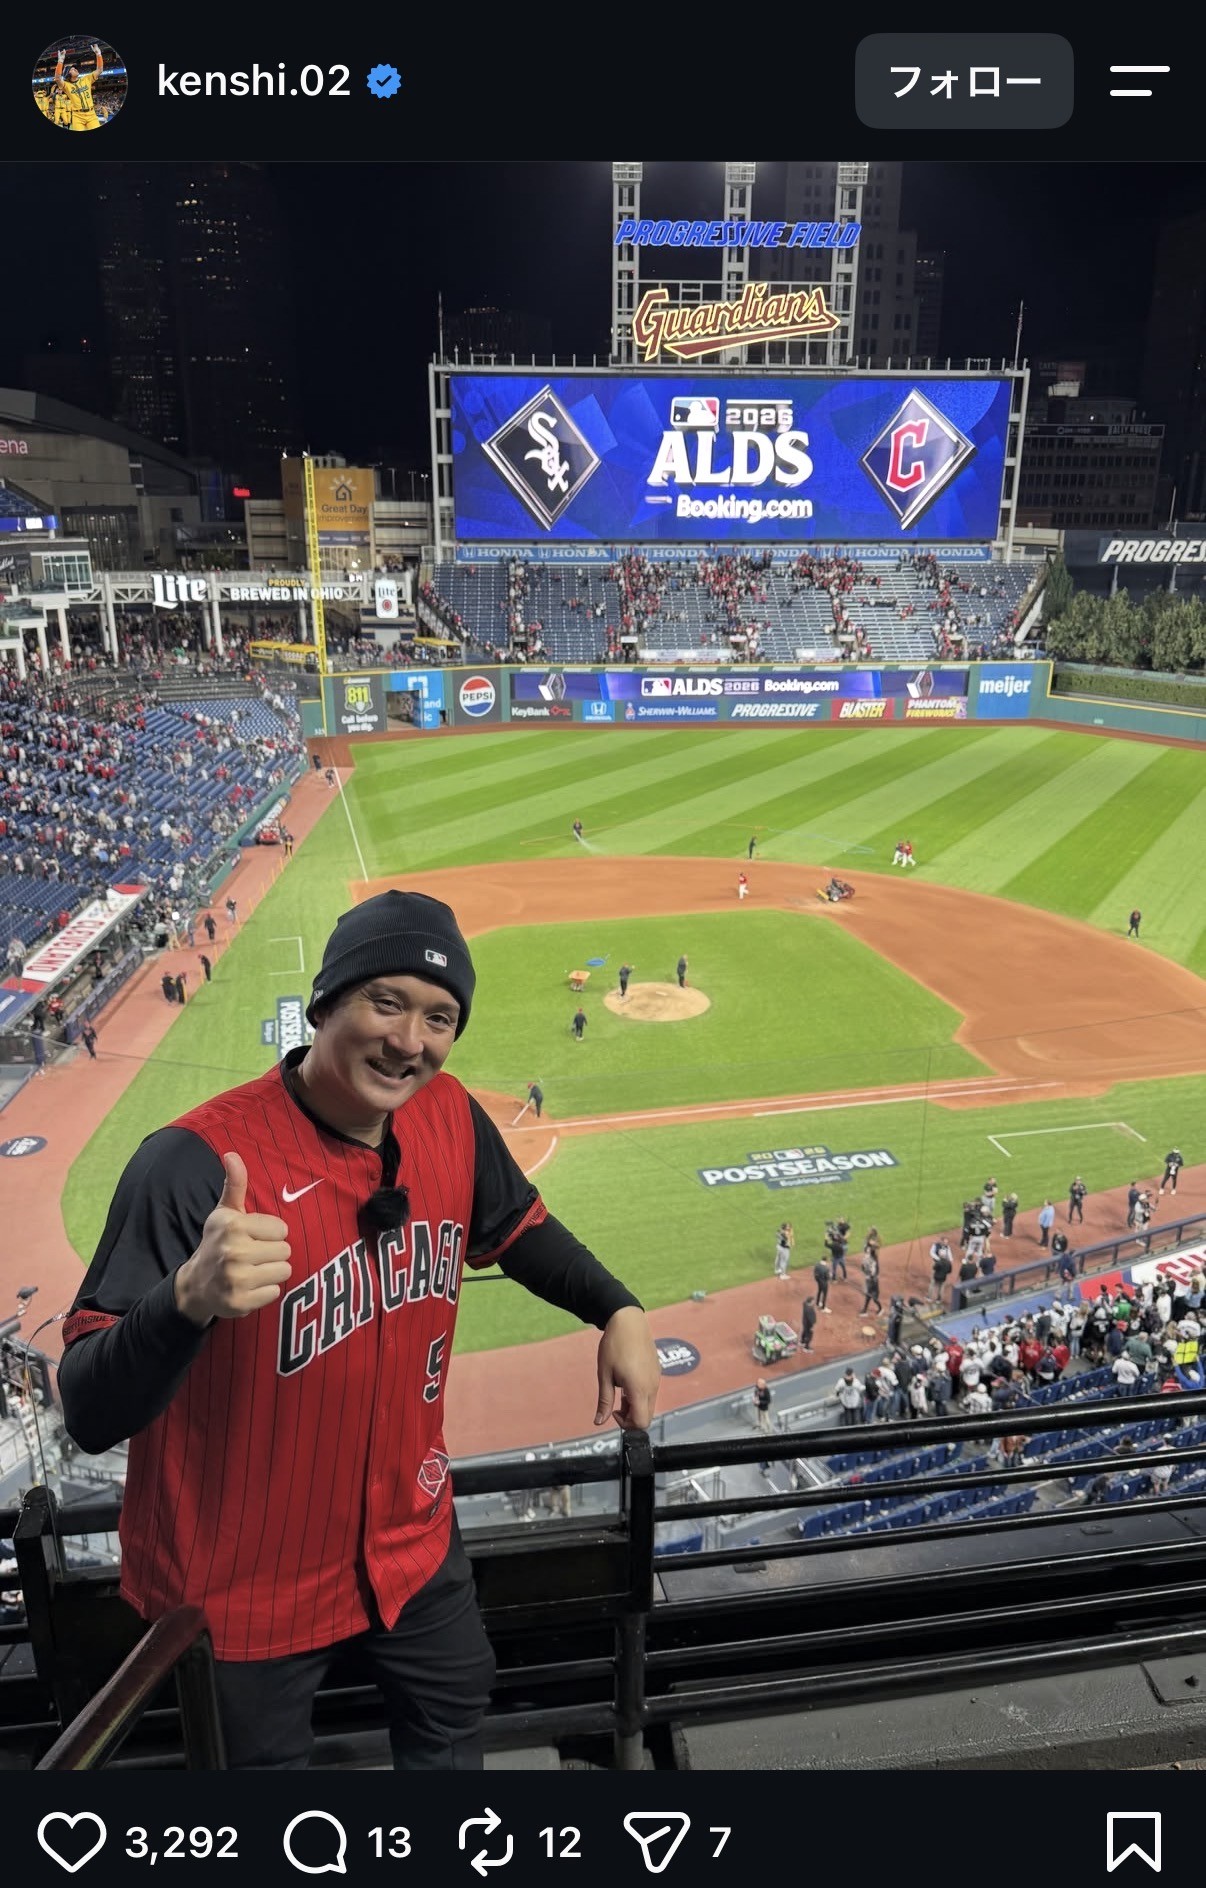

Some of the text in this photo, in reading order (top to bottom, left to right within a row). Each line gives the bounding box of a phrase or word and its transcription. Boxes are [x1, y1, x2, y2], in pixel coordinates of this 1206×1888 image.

[614, 219, 862, 249] PROGRESSIVE FIELD
[633, 283, 841, 361] Guardians
[726, 408, 793, 433] 2026
[0, 439, 28, 454] ena
[646, 430, 814, 487] ALDS
[321, 504, 369, 514] Great Day
[676, 494, 813, 524] Booking.com
[478, 548, 533, 559] HONDA
[552, 548, 610, 559] HONDA
[652, 548, 708, 559] HONDA
[755, 547, 809, 559] HONDA
[855, 547, 910, 558] HONDA
[151, 574, 209, 609] Lite
[268, 579, 306, 588] PROUDLY
[230, 588, 344, 601] BREWED IN OHIO
[346, 685, 370, 704] 811
[673, 678, 724, 696] ALDS
[764, 678, 840, 694] Booking.com
[979, 675, 1032, 698] meijer
[462, 691, 493, 702] PEPSI
[907, 699, 958, 709] PHANTOM
[511, 706, 551, 718] KeyBank
[731, 703, 821, 718] PROGRESSIVE
[839, 702, 887, 719] BLASTER
[906, 709, 955, 718] FIREWORKS
[26, 919, 106, 972] CLEVELAND
[280, 1000, 304, 1060] POSTSEAS
[702, 1151, 895, 1186] POSTSEASON
[276, 1219, 464, 1378] CHICAGO
[656, 1346, 692, 1364] LDS
